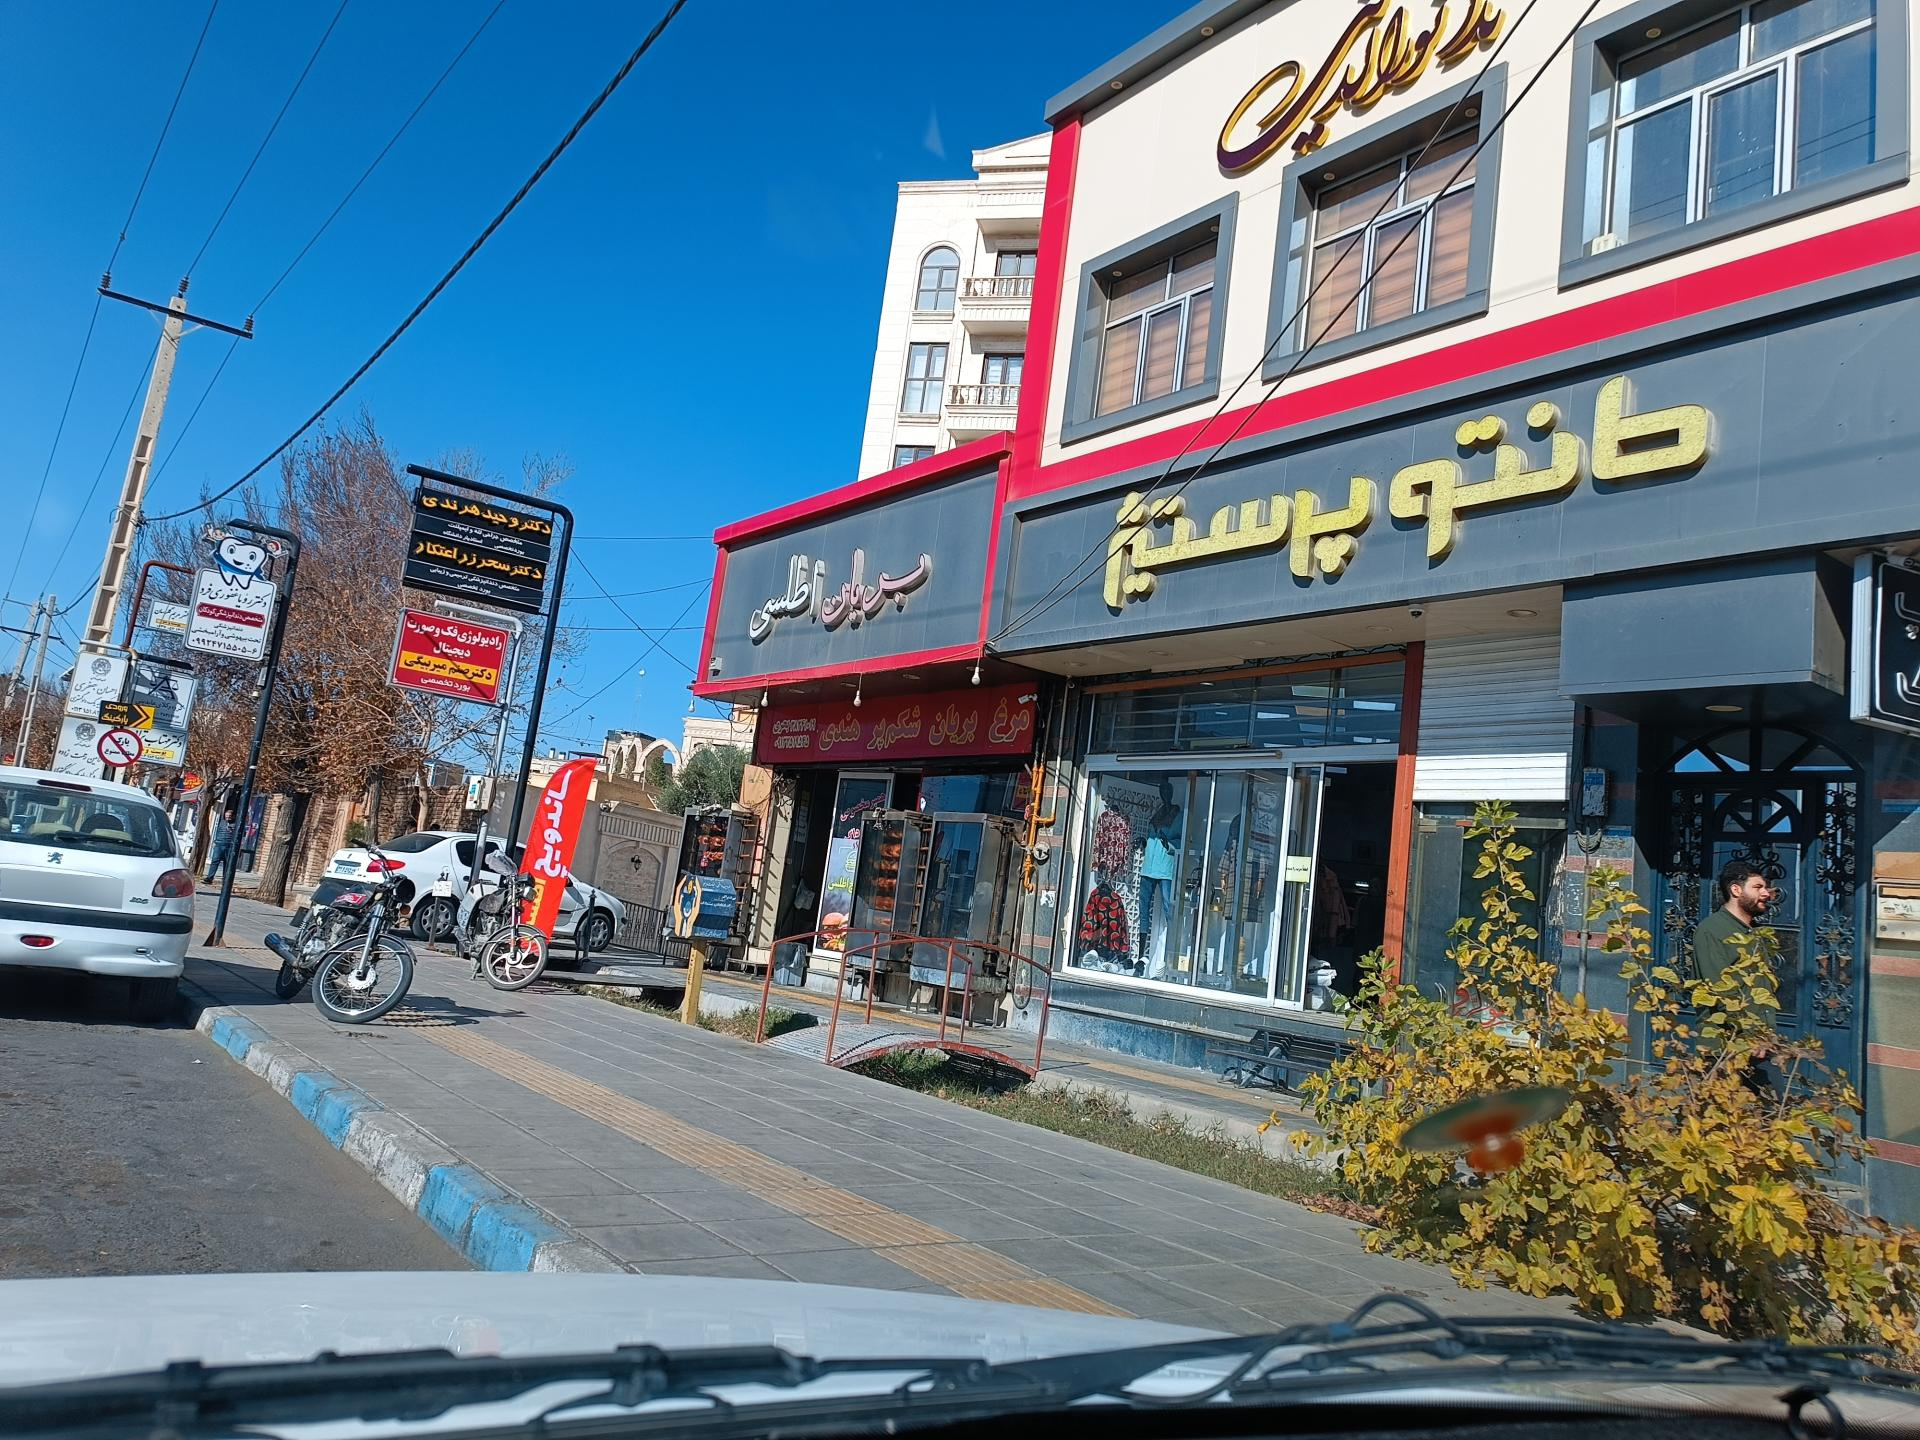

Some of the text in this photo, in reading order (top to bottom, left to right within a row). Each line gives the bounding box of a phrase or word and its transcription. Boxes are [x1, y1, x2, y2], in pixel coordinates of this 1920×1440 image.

[1104, 375, 1715, 609] مانتو پرستیژ
[481, 509, 518, 527] وحید
[519, 519, 551, 534] دکتر
[476, 558, 510, 572] سحر
[510, 565, 543, 580] دکتر
[247, 593, 271, 608] دکتر
[749, 547, 934, 642] بریان اطلسی
[407, 619, 502, 650] رادیولوژی فک و صورت
[433, 642, 471, 659] دیجیتال
[466, 668, 492, 681] دکتر
[421, 677, 471, 692] بورد تخصصی
[105, 703, 128, 713] ورودی
[101, 714, 129, 725] پارکینگ
[929, 704, 978, 746] بریان
[989, 697, 1030, 744] مرغ
[819, 713, 861, 750] هندی
[116, 737, 130, 746] پارک
[163, 734, 185, 749] دکتر
